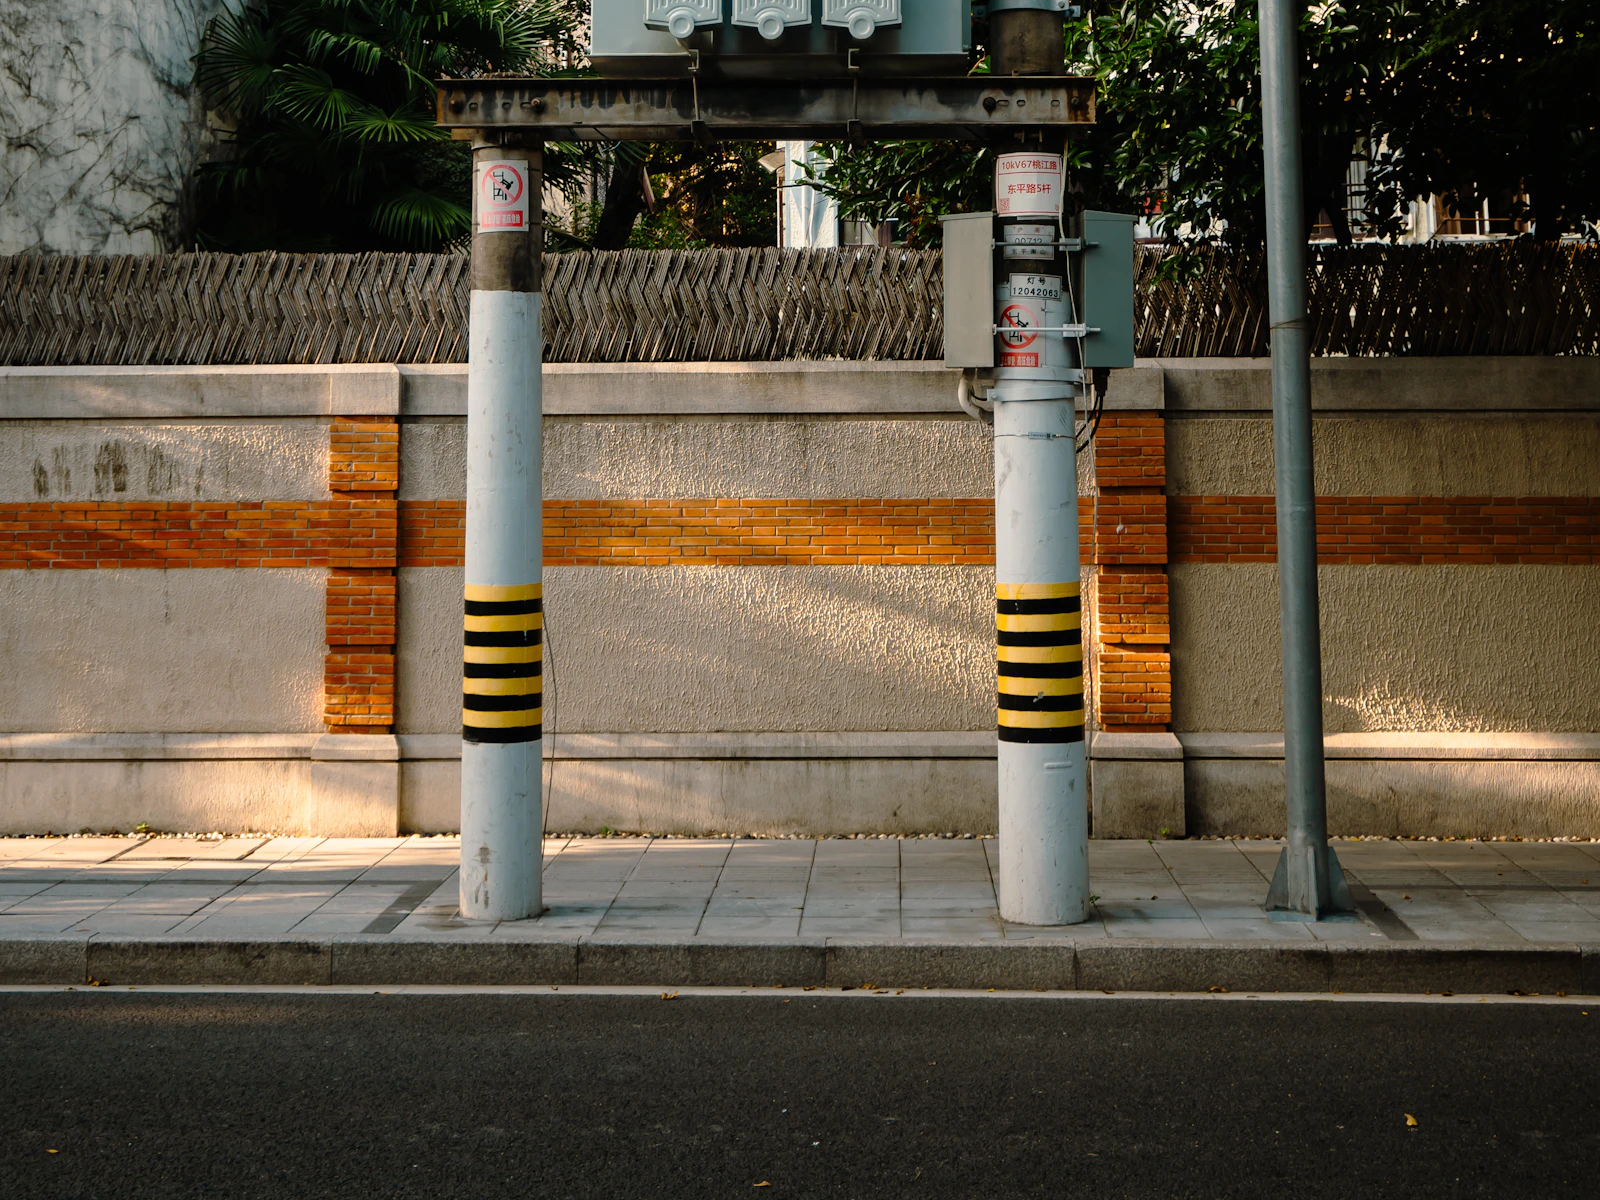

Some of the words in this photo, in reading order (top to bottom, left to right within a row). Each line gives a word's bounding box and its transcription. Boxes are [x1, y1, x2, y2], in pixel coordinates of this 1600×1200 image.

[1002, 160, 1057, 170] 10kV67桃江路
[1008, 183, 1051, 194] 东平路5杆
[1027, 276, 1046, 286] 灯号
[1013, 287, 1059, 298] 12042063
